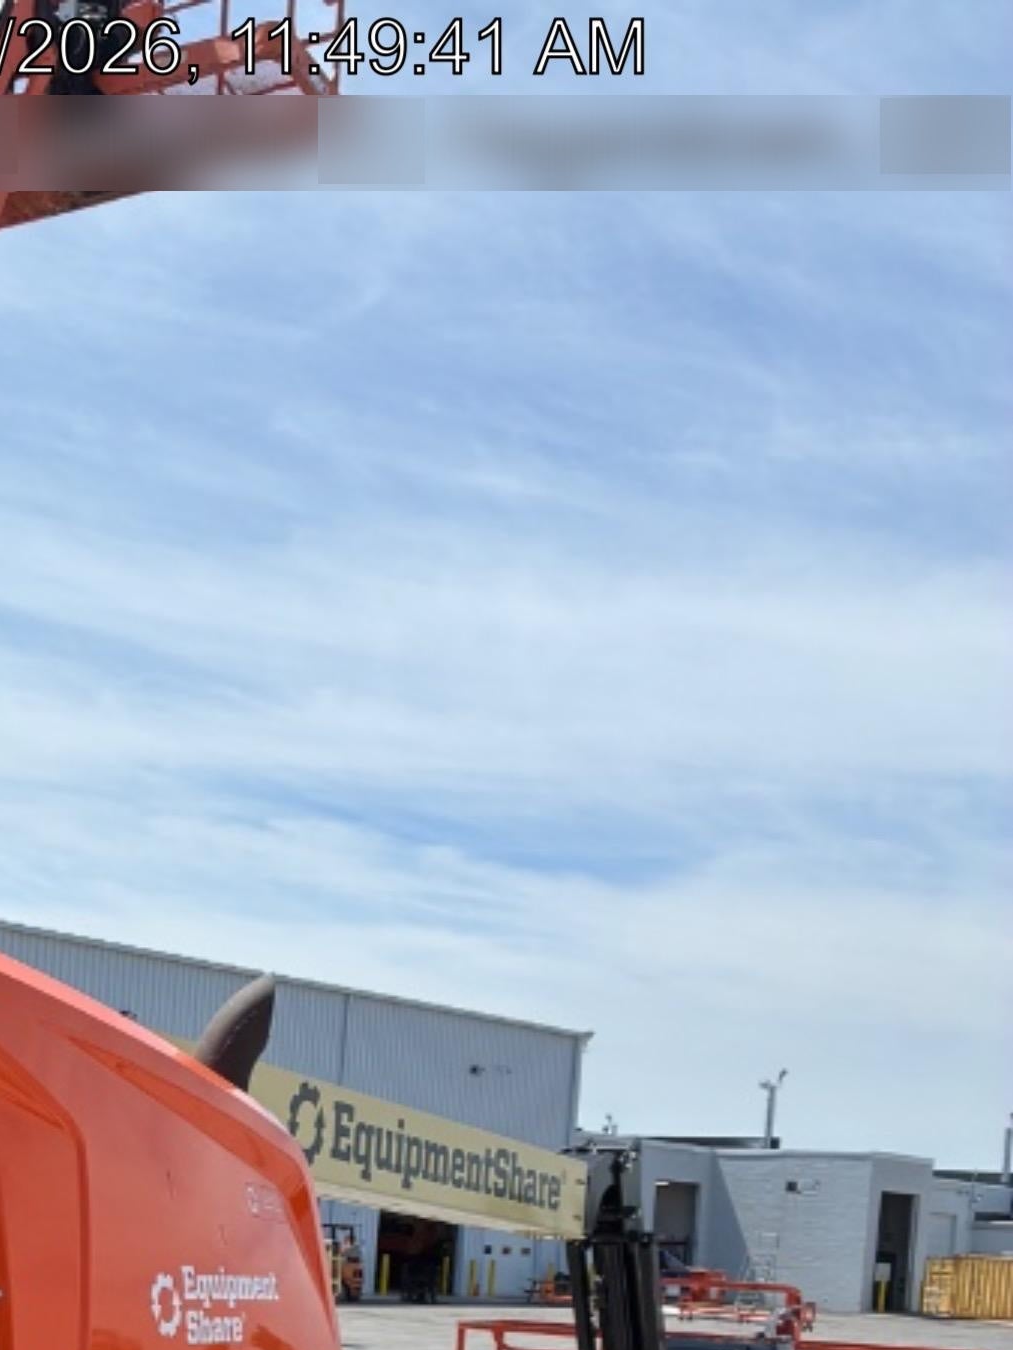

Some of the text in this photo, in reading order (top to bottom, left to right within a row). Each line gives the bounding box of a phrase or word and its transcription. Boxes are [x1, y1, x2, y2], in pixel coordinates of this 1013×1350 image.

[329, 1100, 561, 1211] EquipmentShare
[181, 1266, 279, 1306] Equipment
[187, 1310, 243, 1344] Share
